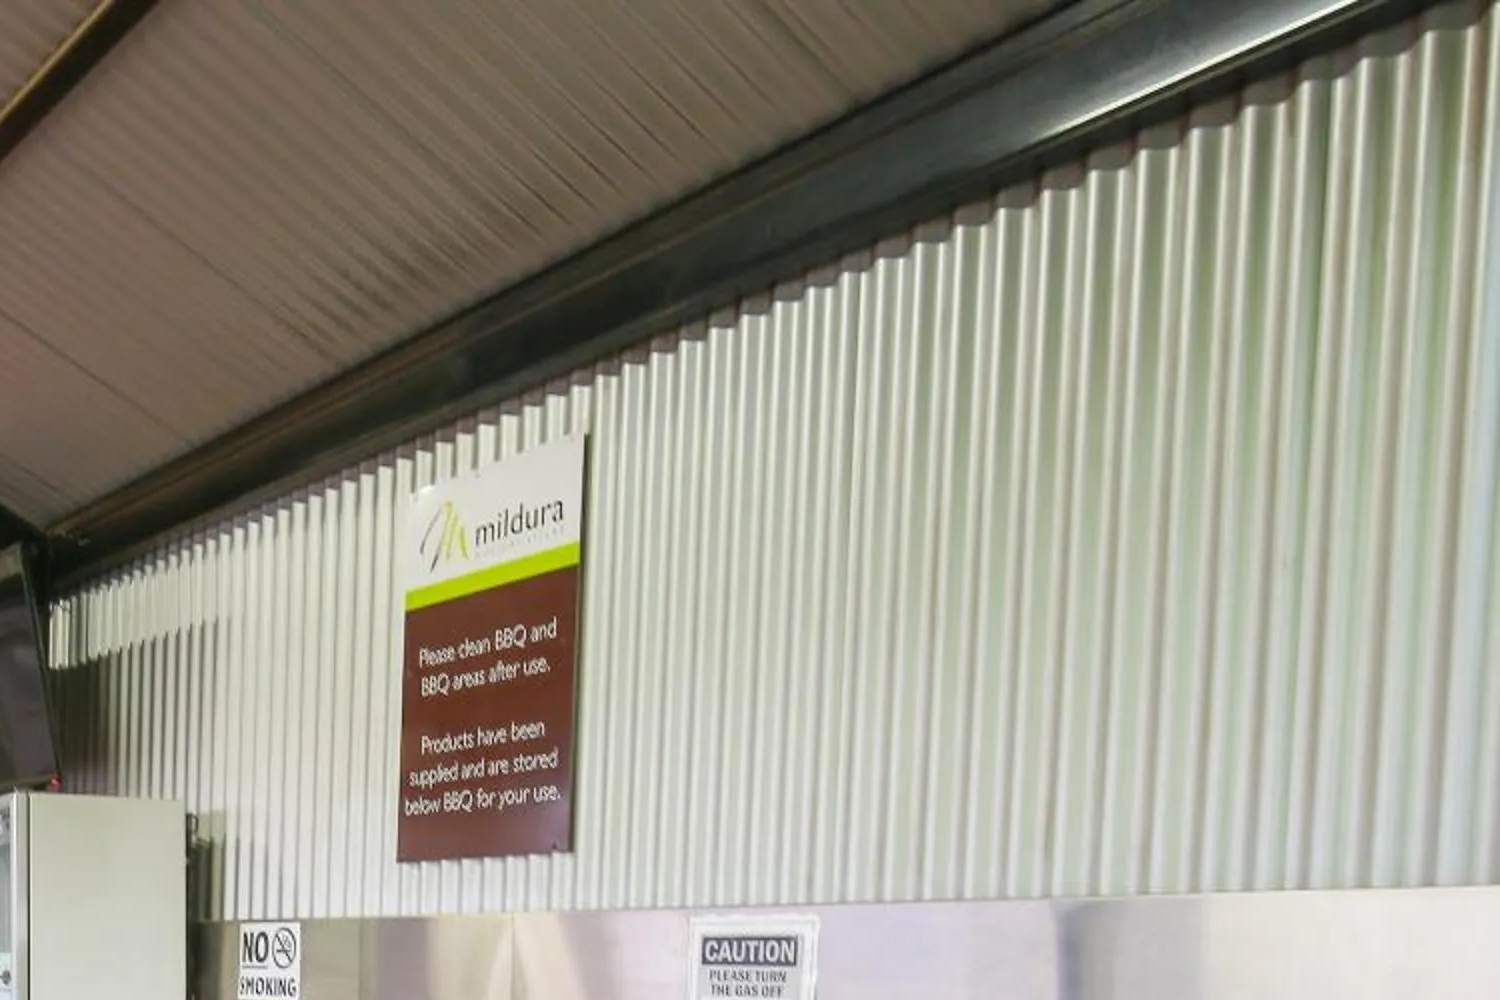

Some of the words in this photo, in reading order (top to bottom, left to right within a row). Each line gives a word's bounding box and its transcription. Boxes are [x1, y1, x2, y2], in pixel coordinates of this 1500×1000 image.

[475, 500, 564, 547] mildura
[419, 645, 456, 669] Please
[457, 637, 491, 660] clean
[495, 623, 527, 650] BBQ
[530, 615, 558, 643] and
[421, 673, 451, 697] BBQ
[451, 668, 486, 691] areas
[488, 659, 521, 683] after
[523, 656, 551, 677] use.
[421, 731, 475, 756] Products
[477, 725, 509, 747] have
[511, 720, 546, 742] been
[408, 759, 459, 791] supplied
[461, 757, 486, 780] and
[487, 759, 510, 777] are
[513, 745, 560, 773] stored
[404, 795, 442, 817] below
[443, 788, 474, 813] BBQ
[476, 787, 497, 810] for
[497, 786, 530, 811] your
[533, 783, 561, 804] use.
[242, 931, 269, 963] NO
[704, 939, 796, 963] CAUTION
[239, 975, 297, 998] SMOKING
[709, 969, 752, 982] PLEASE
[755, 970, 787, 984] TURN
[711, 984, 732, 997] THE
[735, 984, 759, 998] GAS
[761, 985, 783, 998] OFF
